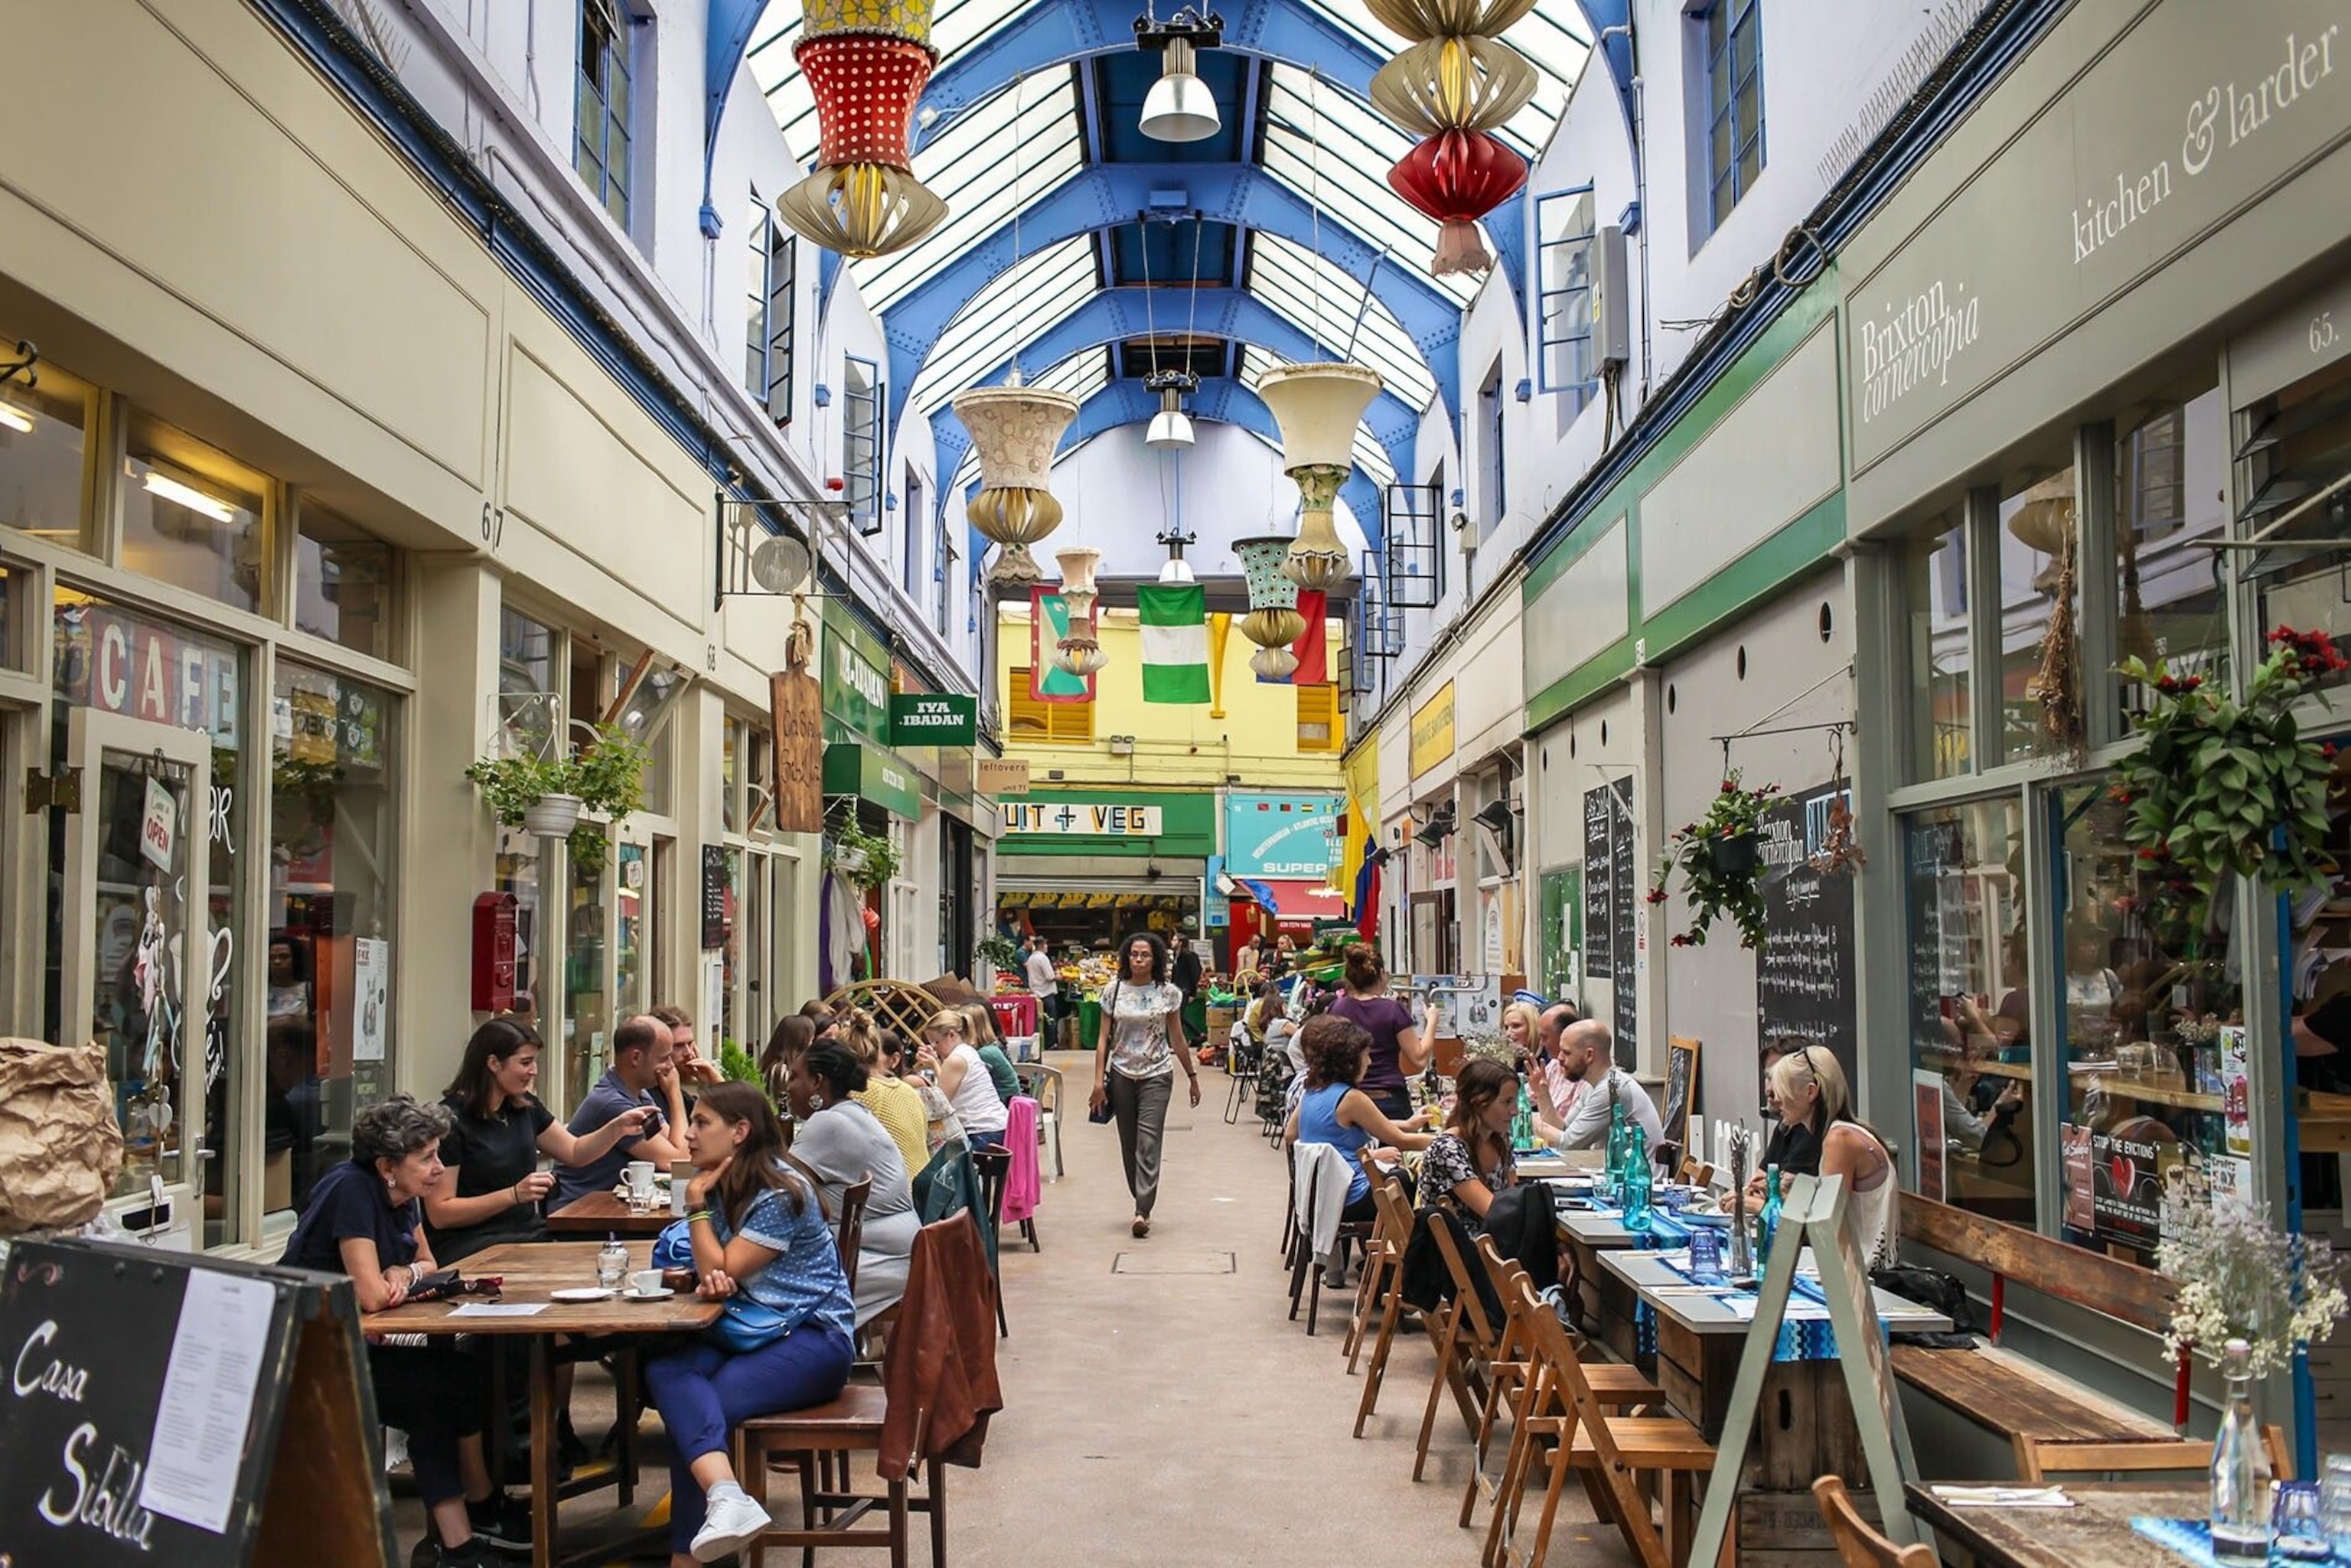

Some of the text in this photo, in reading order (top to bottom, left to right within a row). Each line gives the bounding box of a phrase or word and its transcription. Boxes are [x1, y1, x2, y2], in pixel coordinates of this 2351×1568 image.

[2072, 24, 2339, 265] kitchen & larder
[1861, 279, 1947, 383] Brixton
[1863, 282, 1981, 425] cornercopia
[482, 501, 504, 549] 67
[100, 624, 233, 735] CAFE
[707, 644, 732, 673] 68
[918, 701, 951, 714] IYA
[980, 762, 1026, 771] leftovers
[146, 817, 170, 854] OPEN
[1091, 806, 1145, 833] VEG
[2092, 1135, 2109, 1149] STOP
[2110, 1138, 2122, 1153] THE
[2124, 1141, 2154, 1159] EVICTIONS
[14, 1319, 90, 1403] Casa
